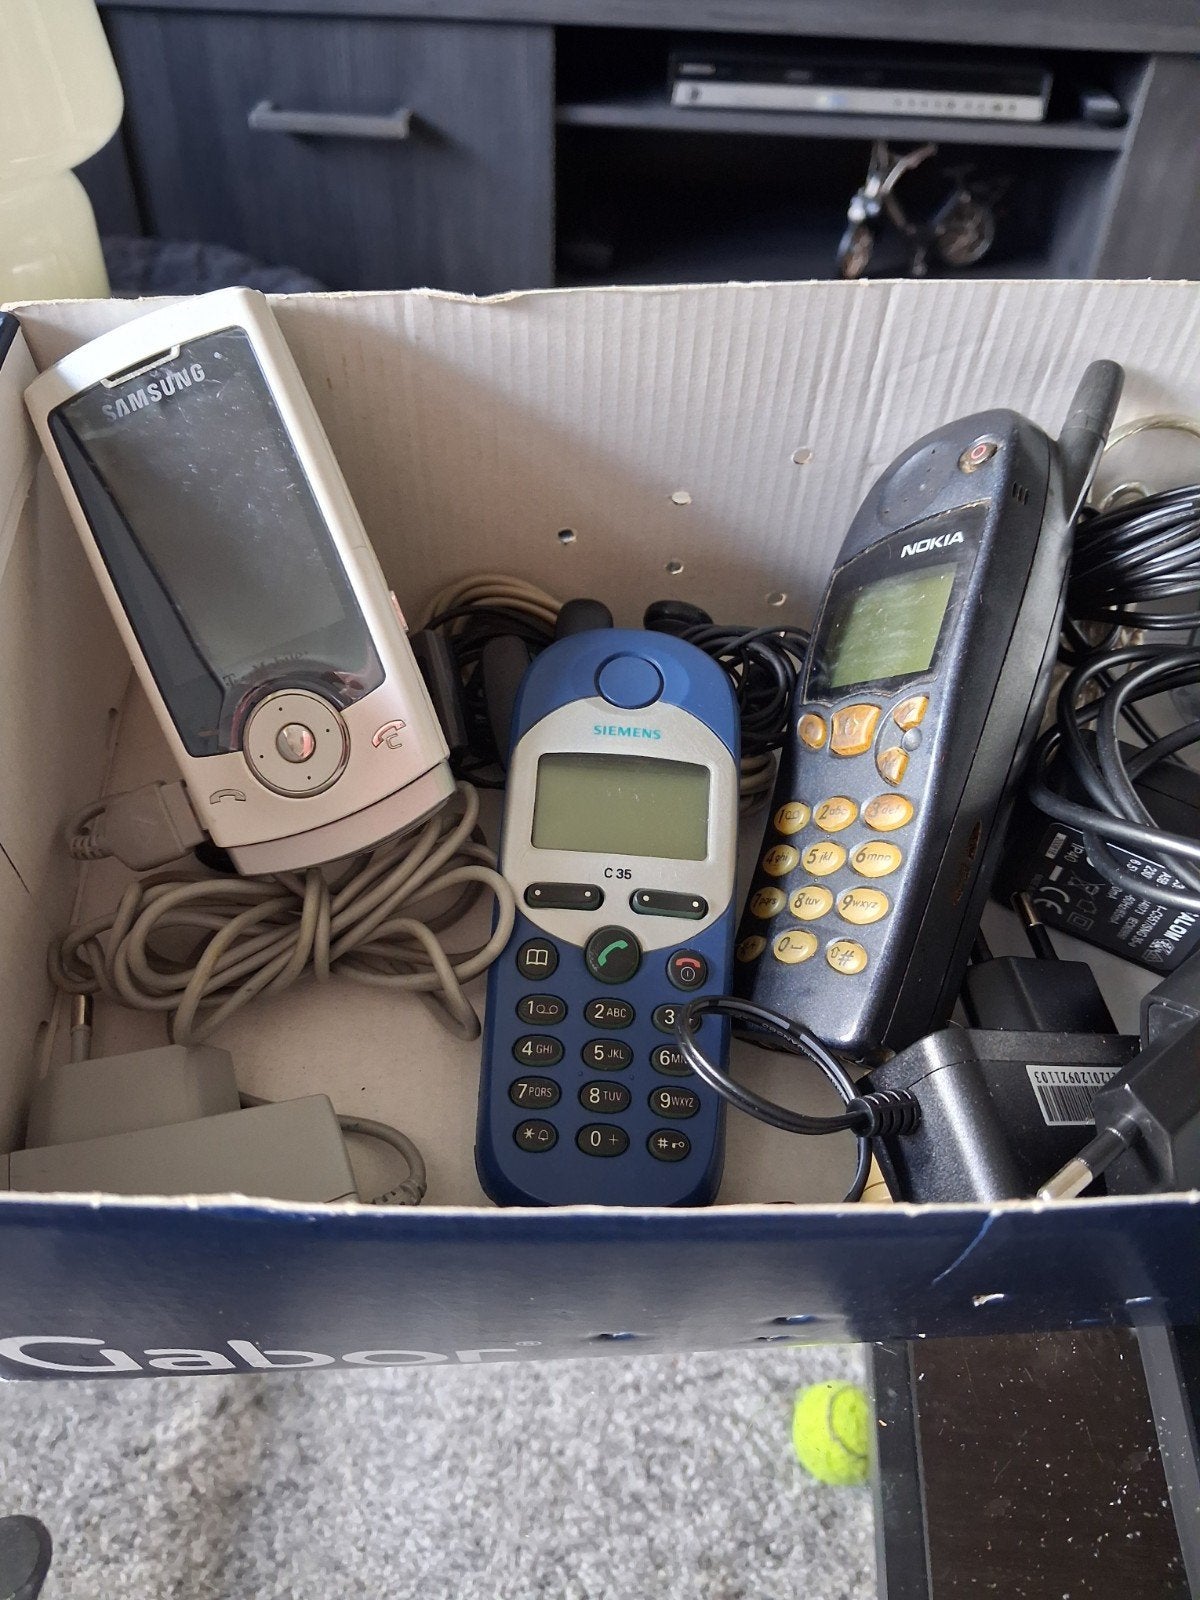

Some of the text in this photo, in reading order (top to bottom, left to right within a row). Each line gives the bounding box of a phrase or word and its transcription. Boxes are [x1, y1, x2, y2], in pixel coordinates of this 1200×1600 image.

[101, 363, 206, 421] SAMSUNG
[900, 530, 964, 559] NOKIA
[593, 724, 662, 740] SIEMENS
[818, 804, 830, 820] 2
[806, 848, 819, 865] 5
[855, 846, 869, 864] 6
[1063, 842, 1085, 863] IP40
[604, 867, 632, 880] C 35
[793, 892, 806, 909] 8
[842, 894, 854, 911] 9
[527, 1000, 534, 1015] 1
[593, 1003, 627, 1019] 2 ABC
[664, 1009, 675, 1025] 3
[521, 1041, 553, 1056] 4 GHI
[593, 1045, 625, 1061] 5 JKL
[659, 1049, 671, 1066] 6
[517, 1083, 528, 1099] 7
[589, 1087, 622, 1104] 8 TUV
[660, 1092, 671, 1108] 9
[590, 1130, 601, 1147] 0
[657, 1137, 669, 1149] #
[0, 1335, 518, 1373] Gabor
